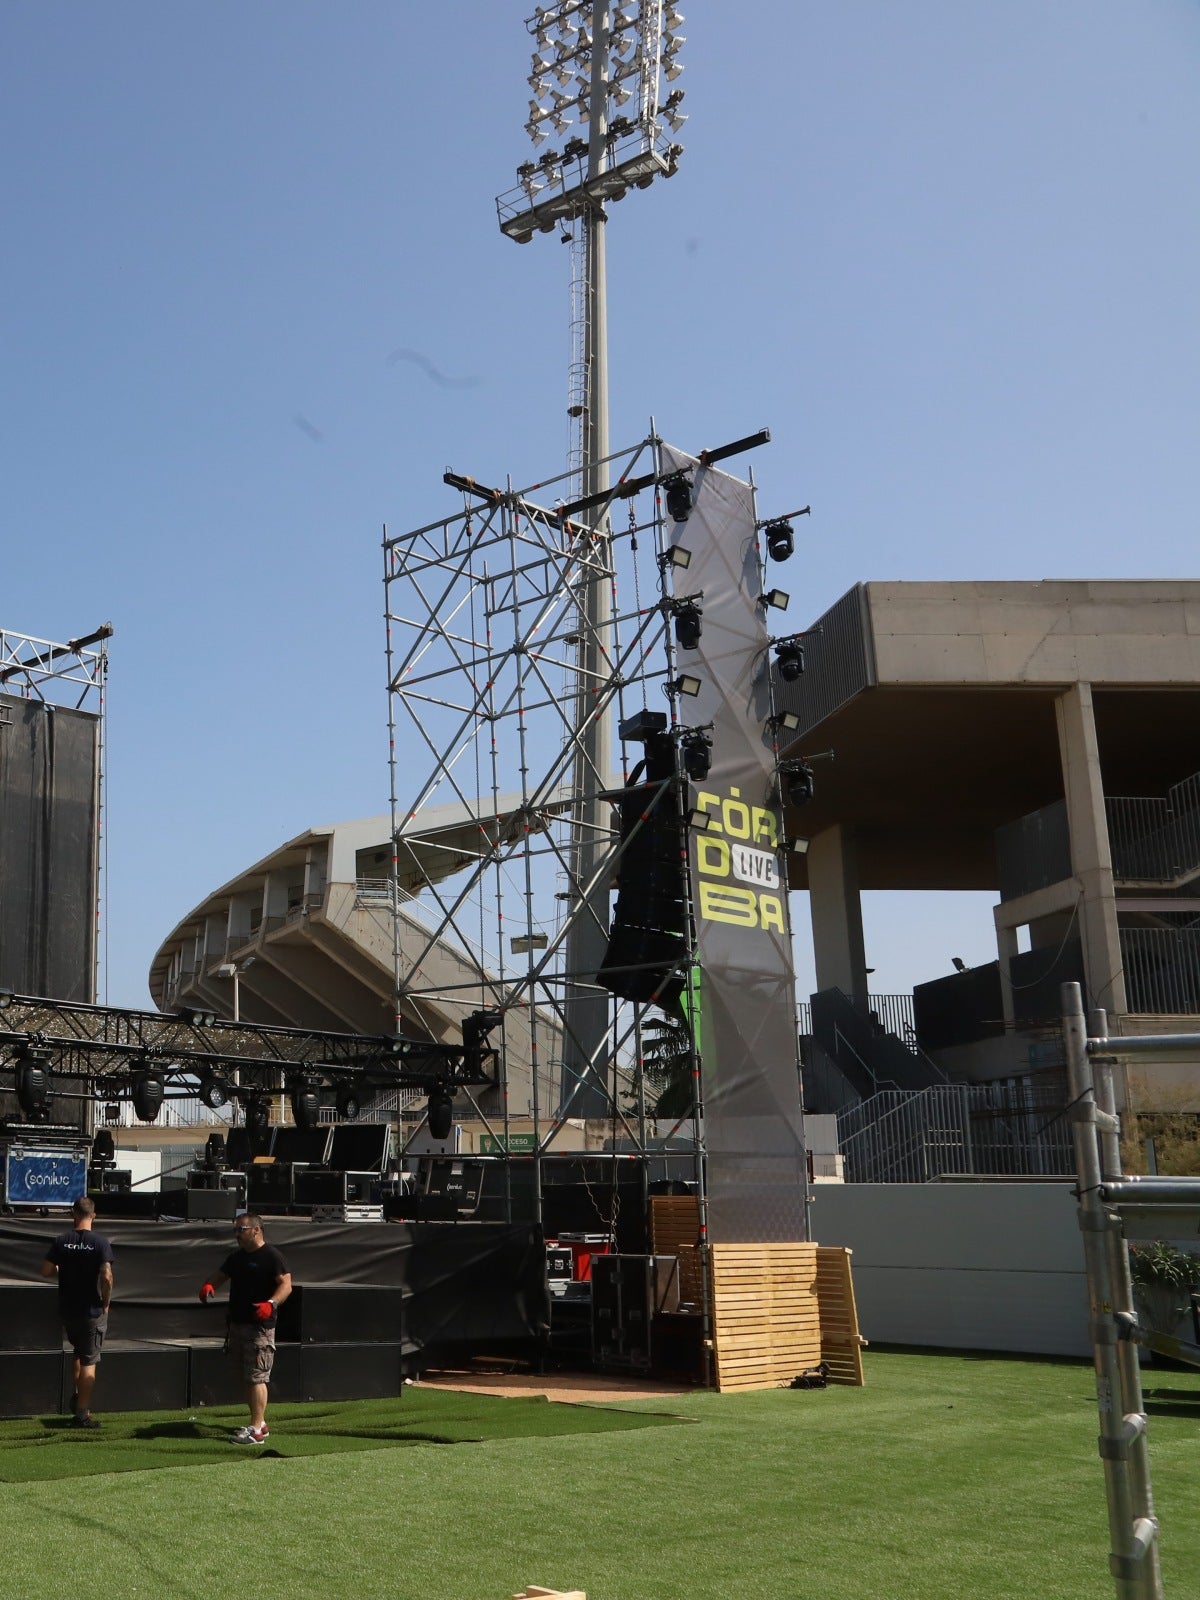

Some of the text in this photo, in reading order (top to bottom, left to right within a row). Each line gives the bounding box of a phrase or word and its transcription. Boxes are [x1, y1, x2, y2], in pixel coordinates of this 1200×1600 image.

[696, 834, 773, 882] D LIVE
[699, 880, 785, 935] BA
